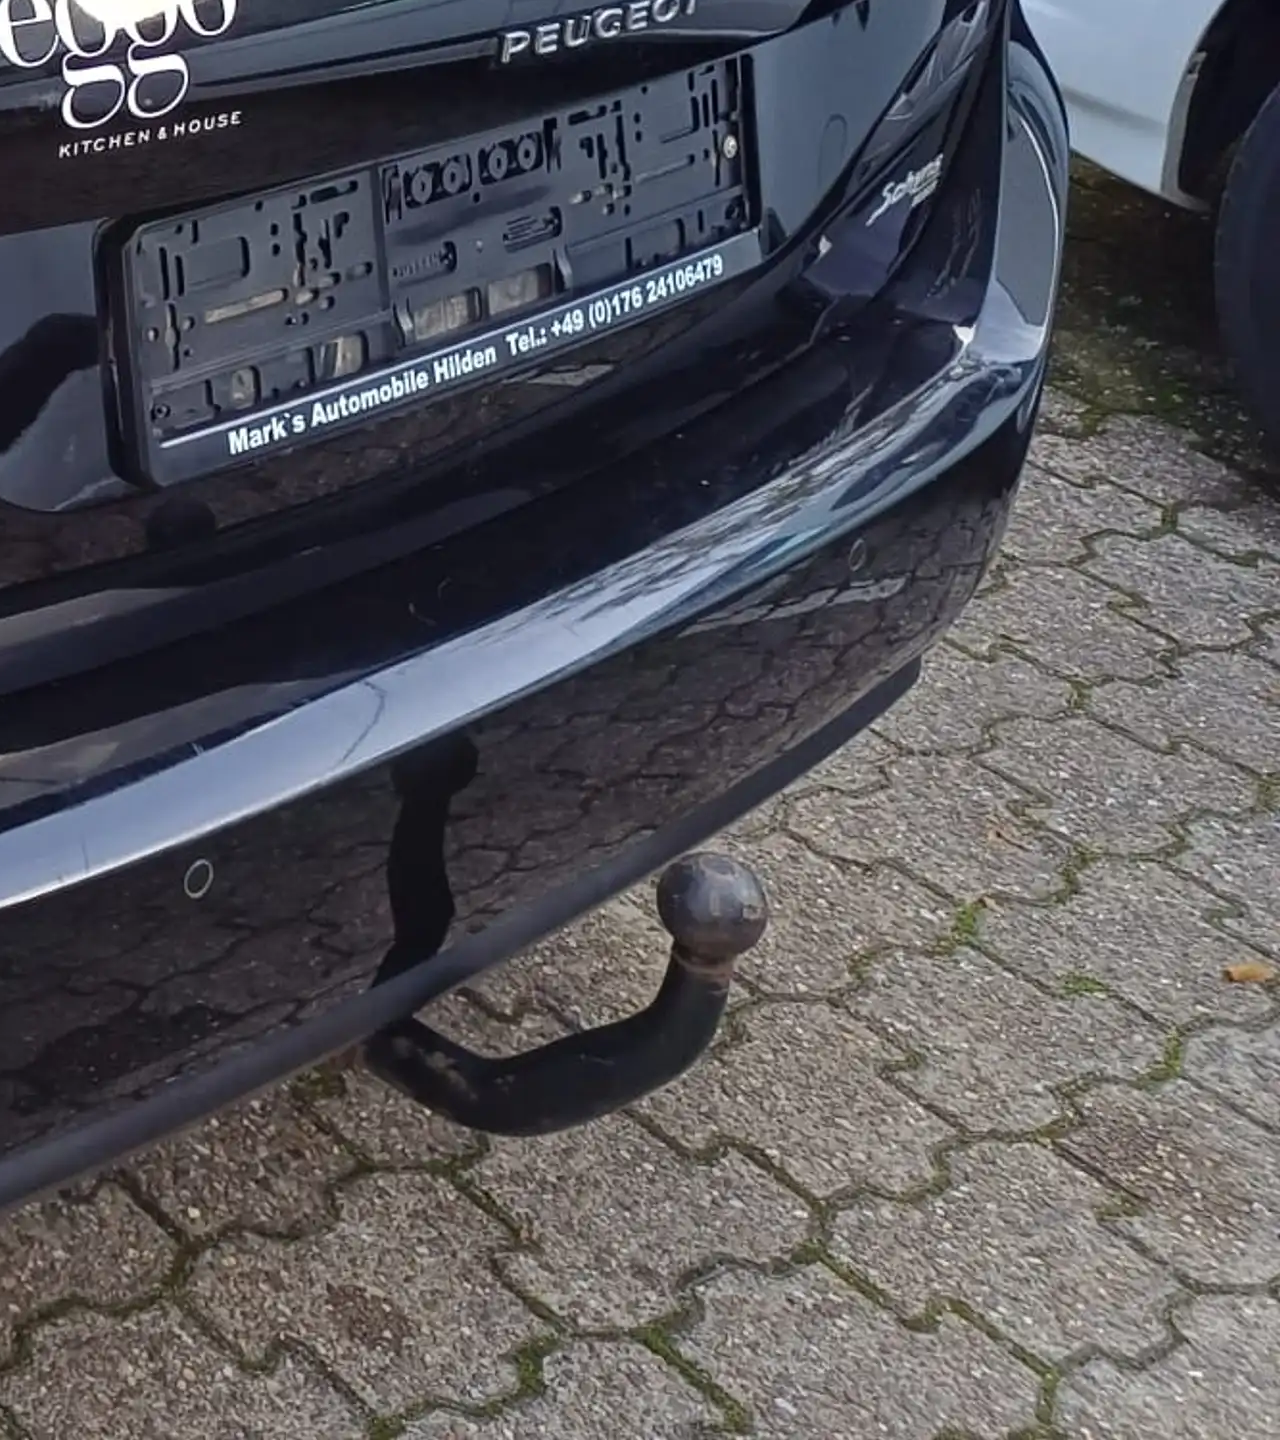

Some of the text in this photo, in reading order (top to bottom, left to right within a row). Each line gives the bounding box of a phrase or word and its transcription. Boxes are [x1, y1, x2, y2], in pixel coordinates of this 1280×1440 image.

[58, 110, 243, 159] KITCHEN & HOUSE
[310, 370, 429, 428] Automobile
[432, 345, 498, 384] Hilden
[504, 326, 548, 357] Tel.:
[550, 308, 585, 338] +49
[588, 286, 643, 329] (0)176
[645, 253, 724, 304] 24106479
